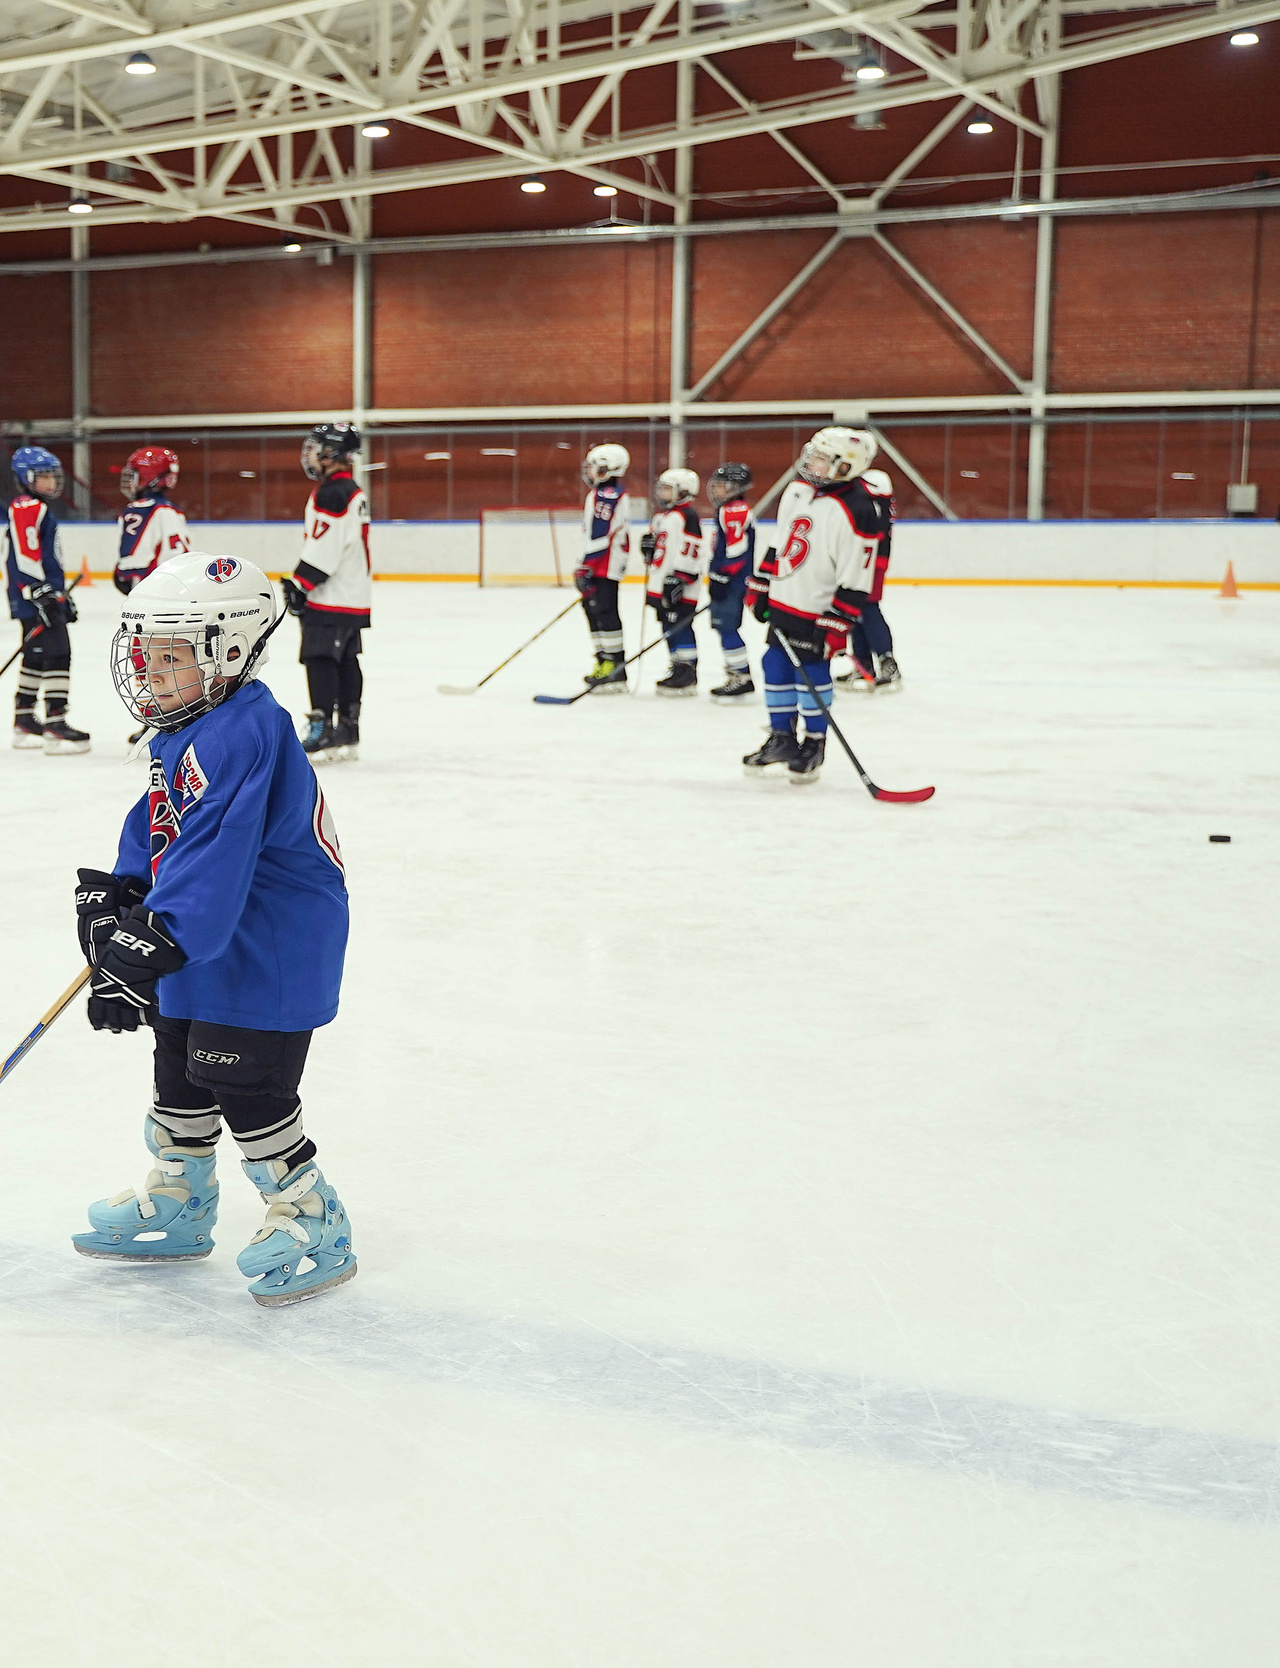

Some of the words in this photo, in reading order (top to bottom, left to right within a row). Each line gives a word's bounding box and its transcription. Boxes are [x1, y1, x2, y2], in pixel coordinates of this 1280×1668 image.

[25, 525, 39, 551] 8
[121, 612, 145, 620] BAUER
[230, 608, 260, 618] BAUER
[196, 1049, 234, 1065] CCM
